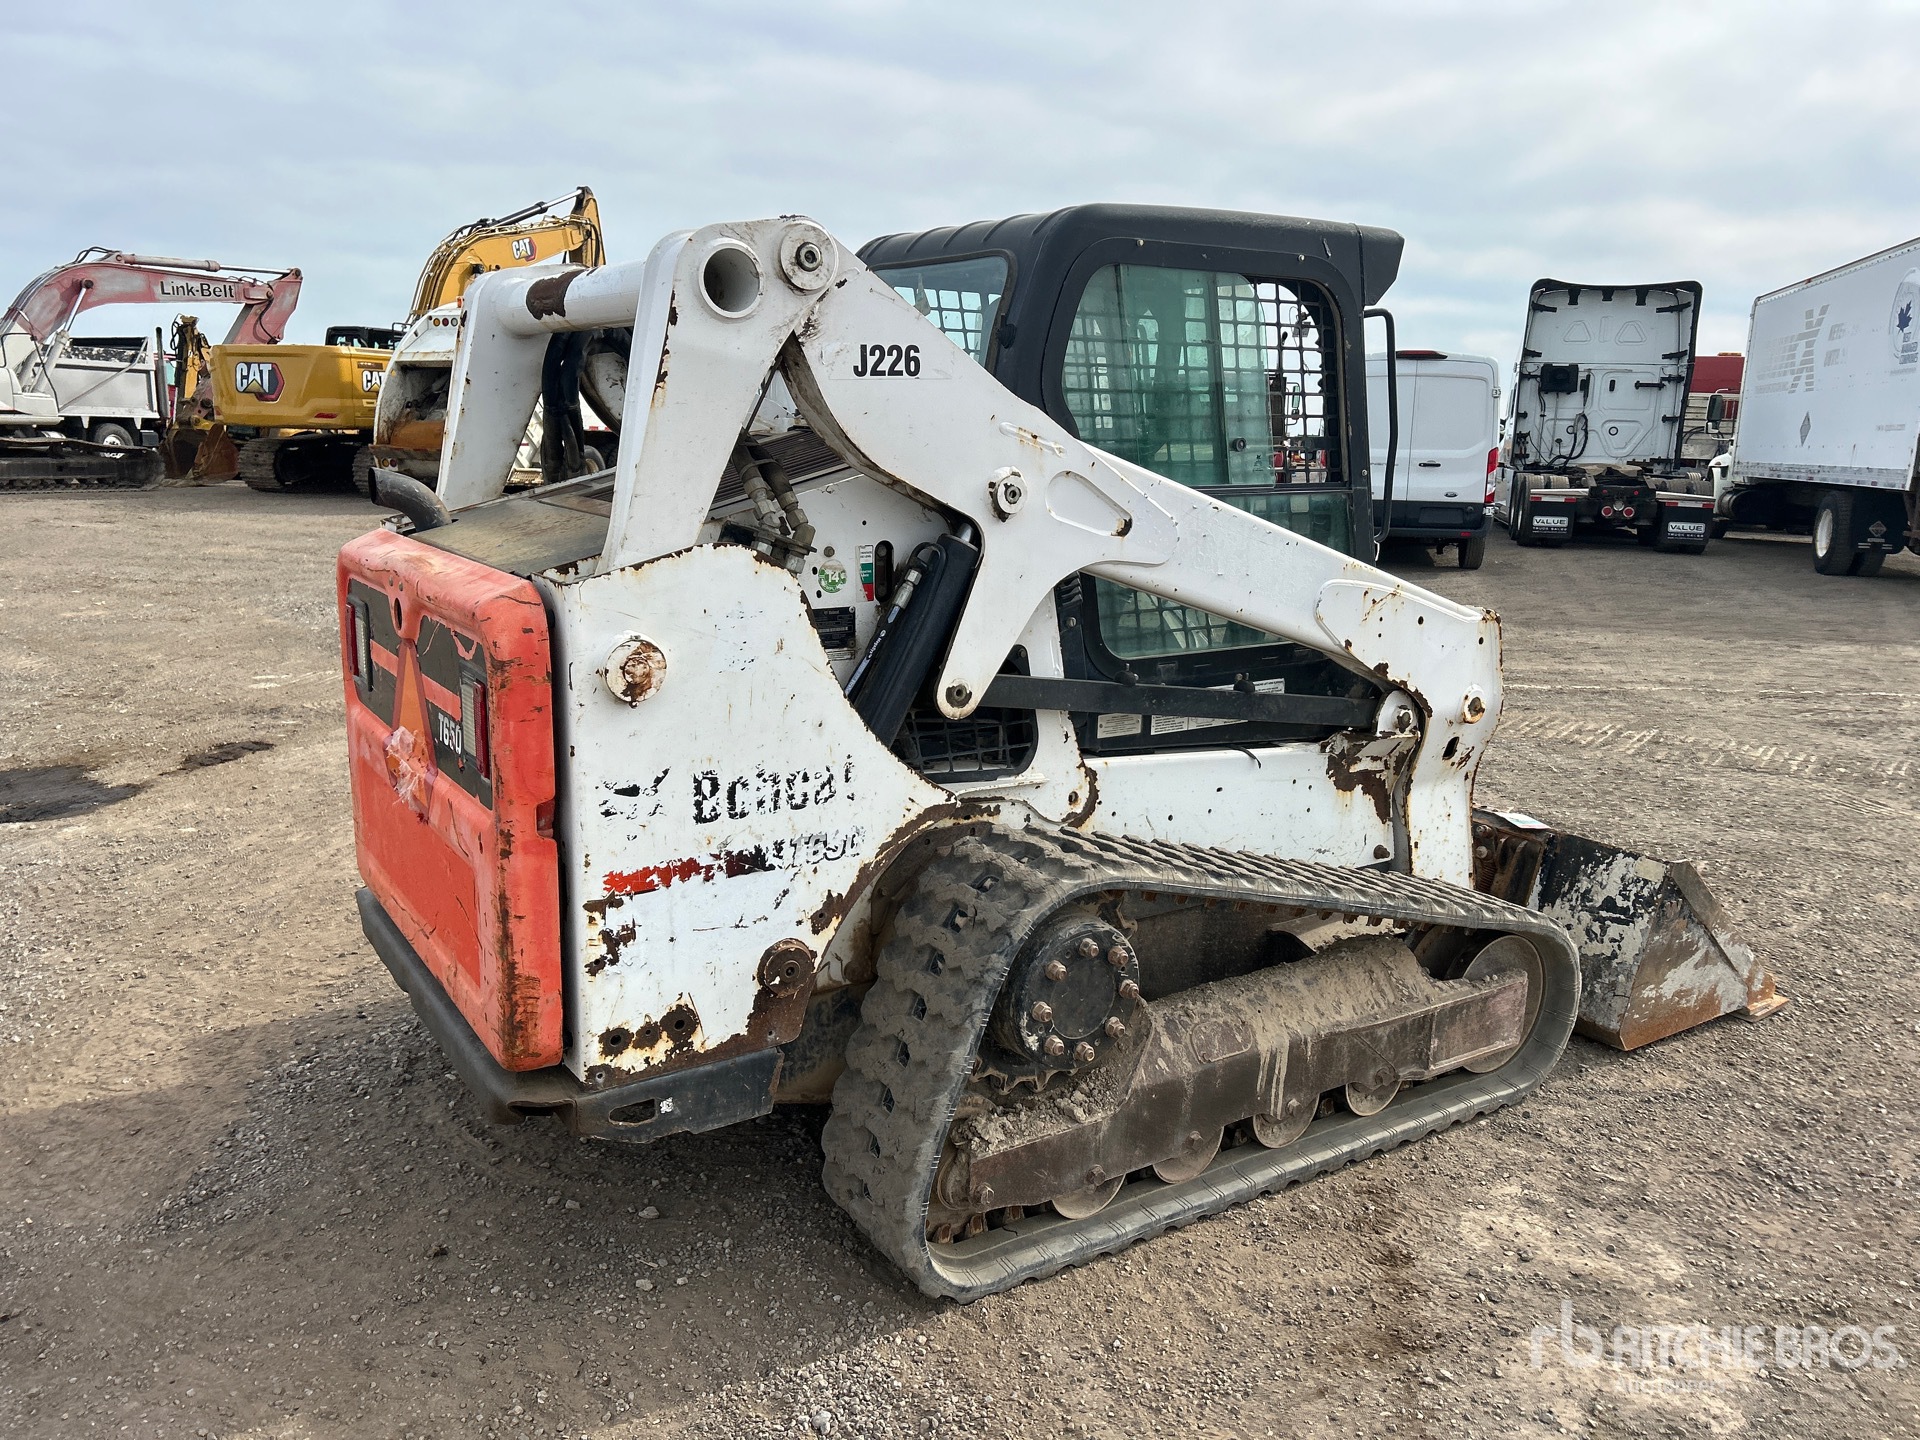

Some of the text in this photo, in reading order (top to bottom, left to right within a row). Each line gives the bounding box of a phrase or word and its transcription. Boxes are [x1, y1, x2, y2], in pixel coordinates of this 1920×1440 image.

[512, 238, 531, 259] CAT
[160, 281, 234, 298] Link-Belt
[853, 344, 920, 377] J226
[236, 363, 272, 393] CAT
[438, 713, 462, 754] T650
